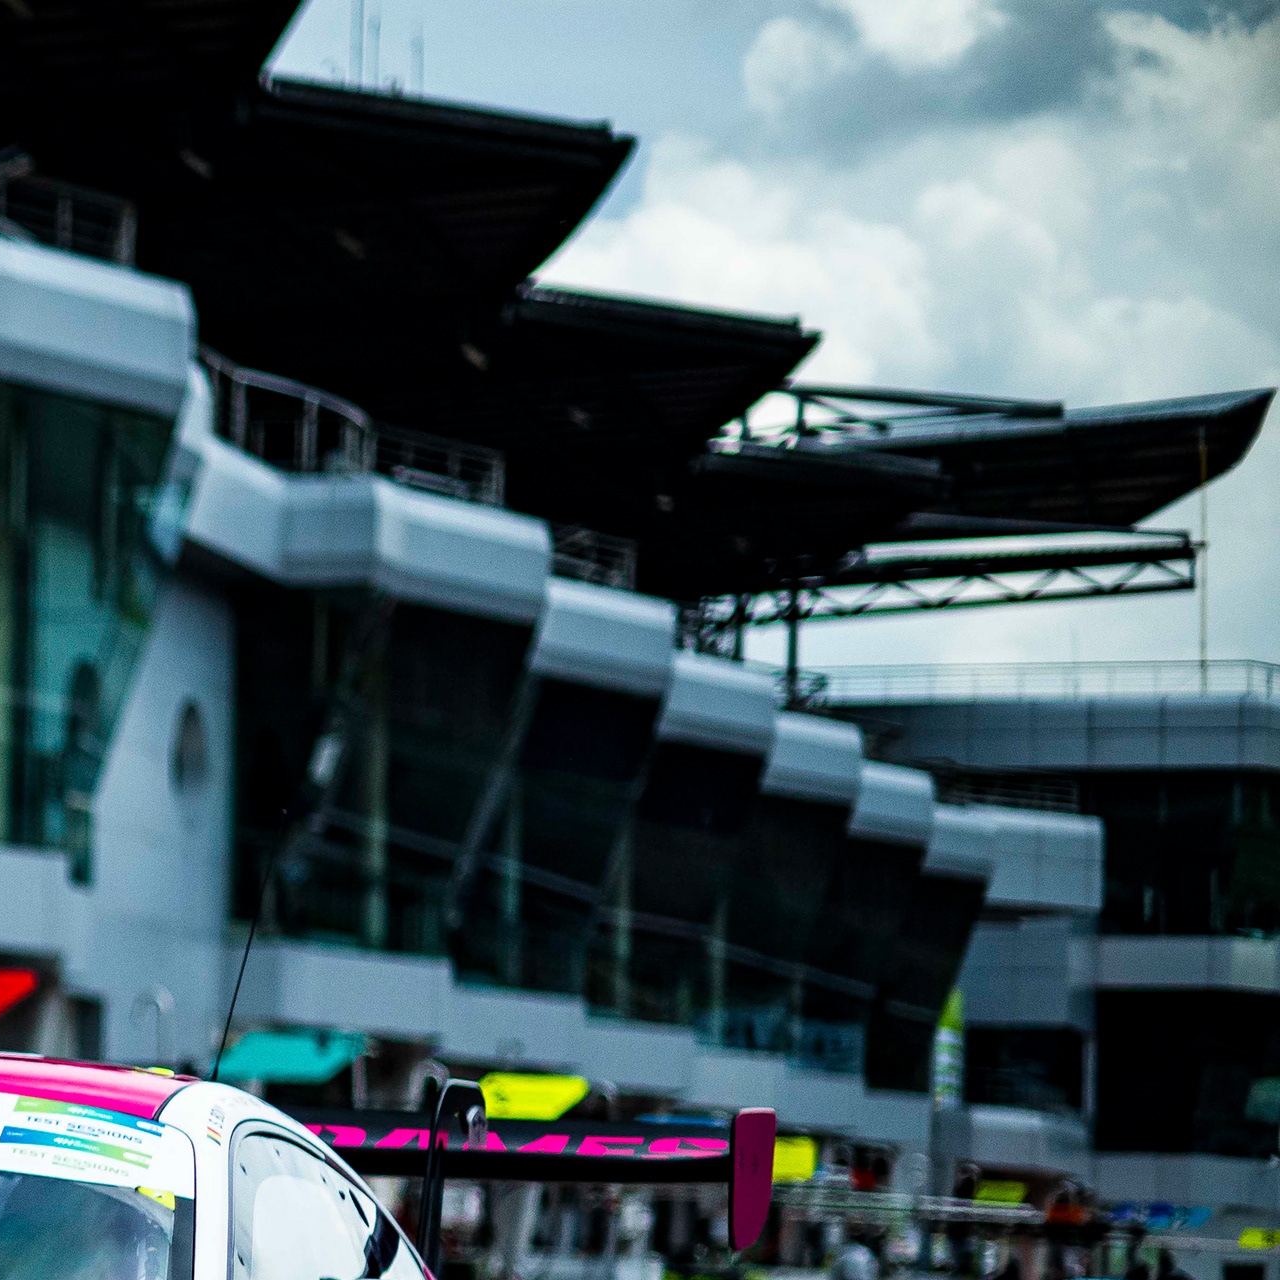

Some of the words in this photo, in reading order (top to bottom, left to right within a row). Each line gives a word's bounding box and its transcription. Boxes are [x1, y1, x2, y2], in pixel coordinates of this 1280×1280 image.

[27, 1115, 61, 1127] TEST
[66, 1122, 143, 1144] SESSIONS
[11, 1147, 46, 1159] TEST
[52, 1154, 130, 1177] SESSIONS
